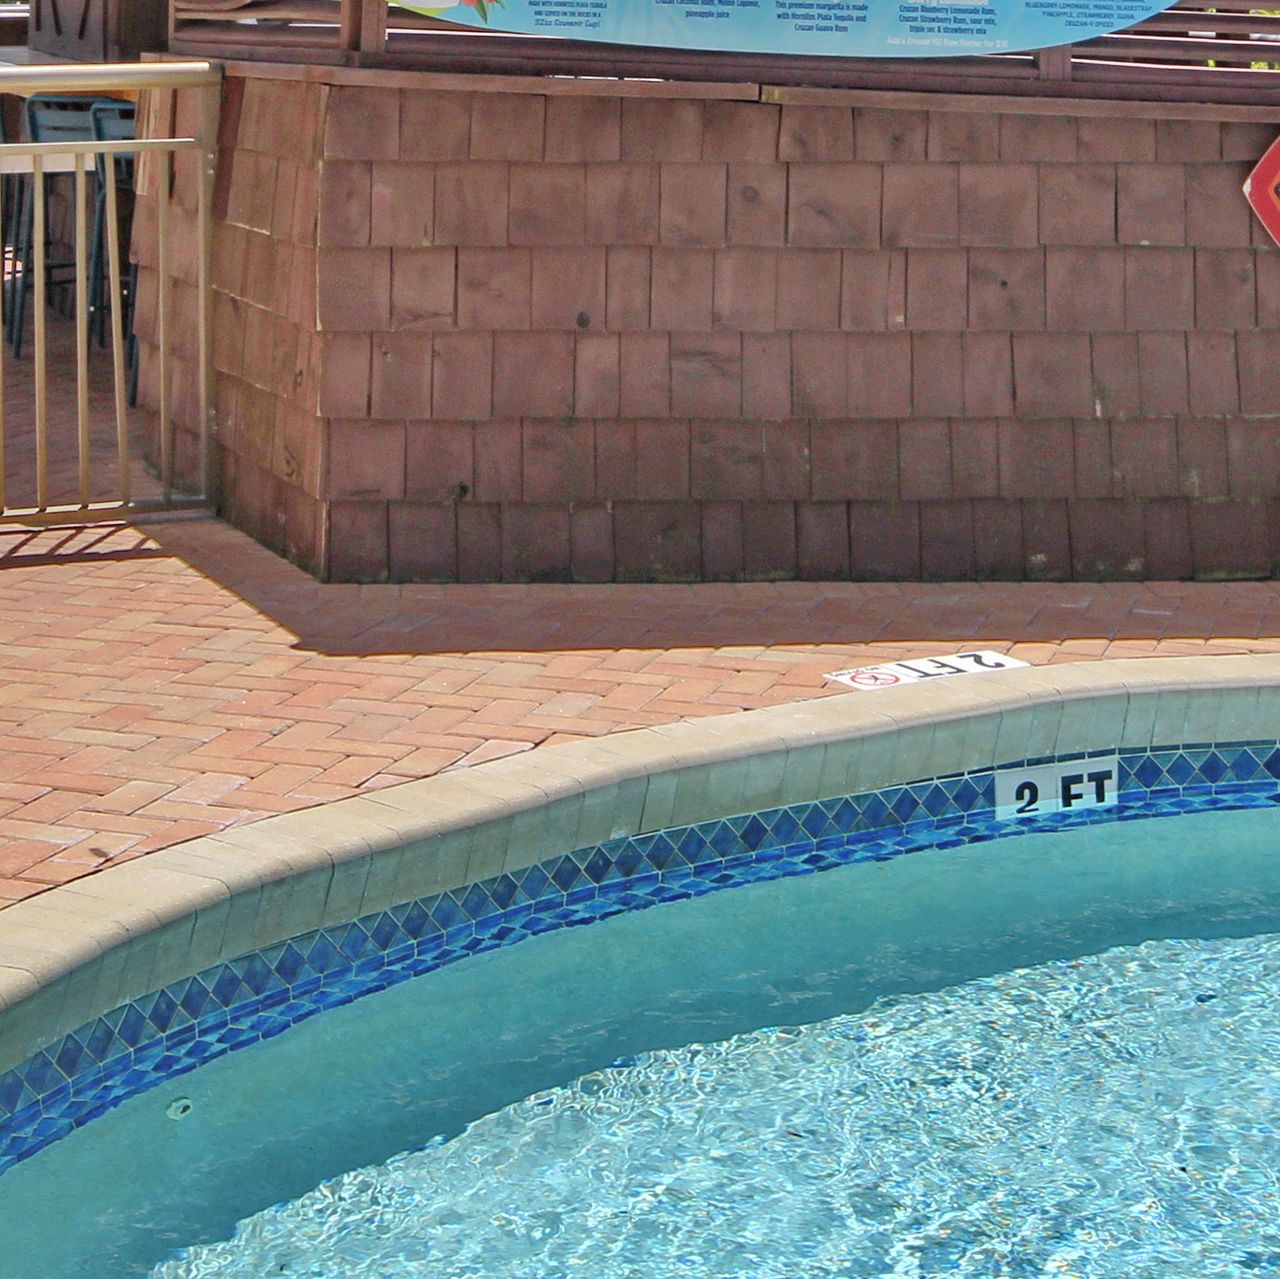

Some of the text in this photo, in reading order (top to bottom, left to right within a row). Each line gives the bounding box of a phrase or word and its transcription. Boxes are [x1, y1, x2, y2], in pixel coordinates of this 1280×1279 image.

[895, 653, 1006, 679] 2 FT
[1015, 769, 1114, 815] 2 FT
